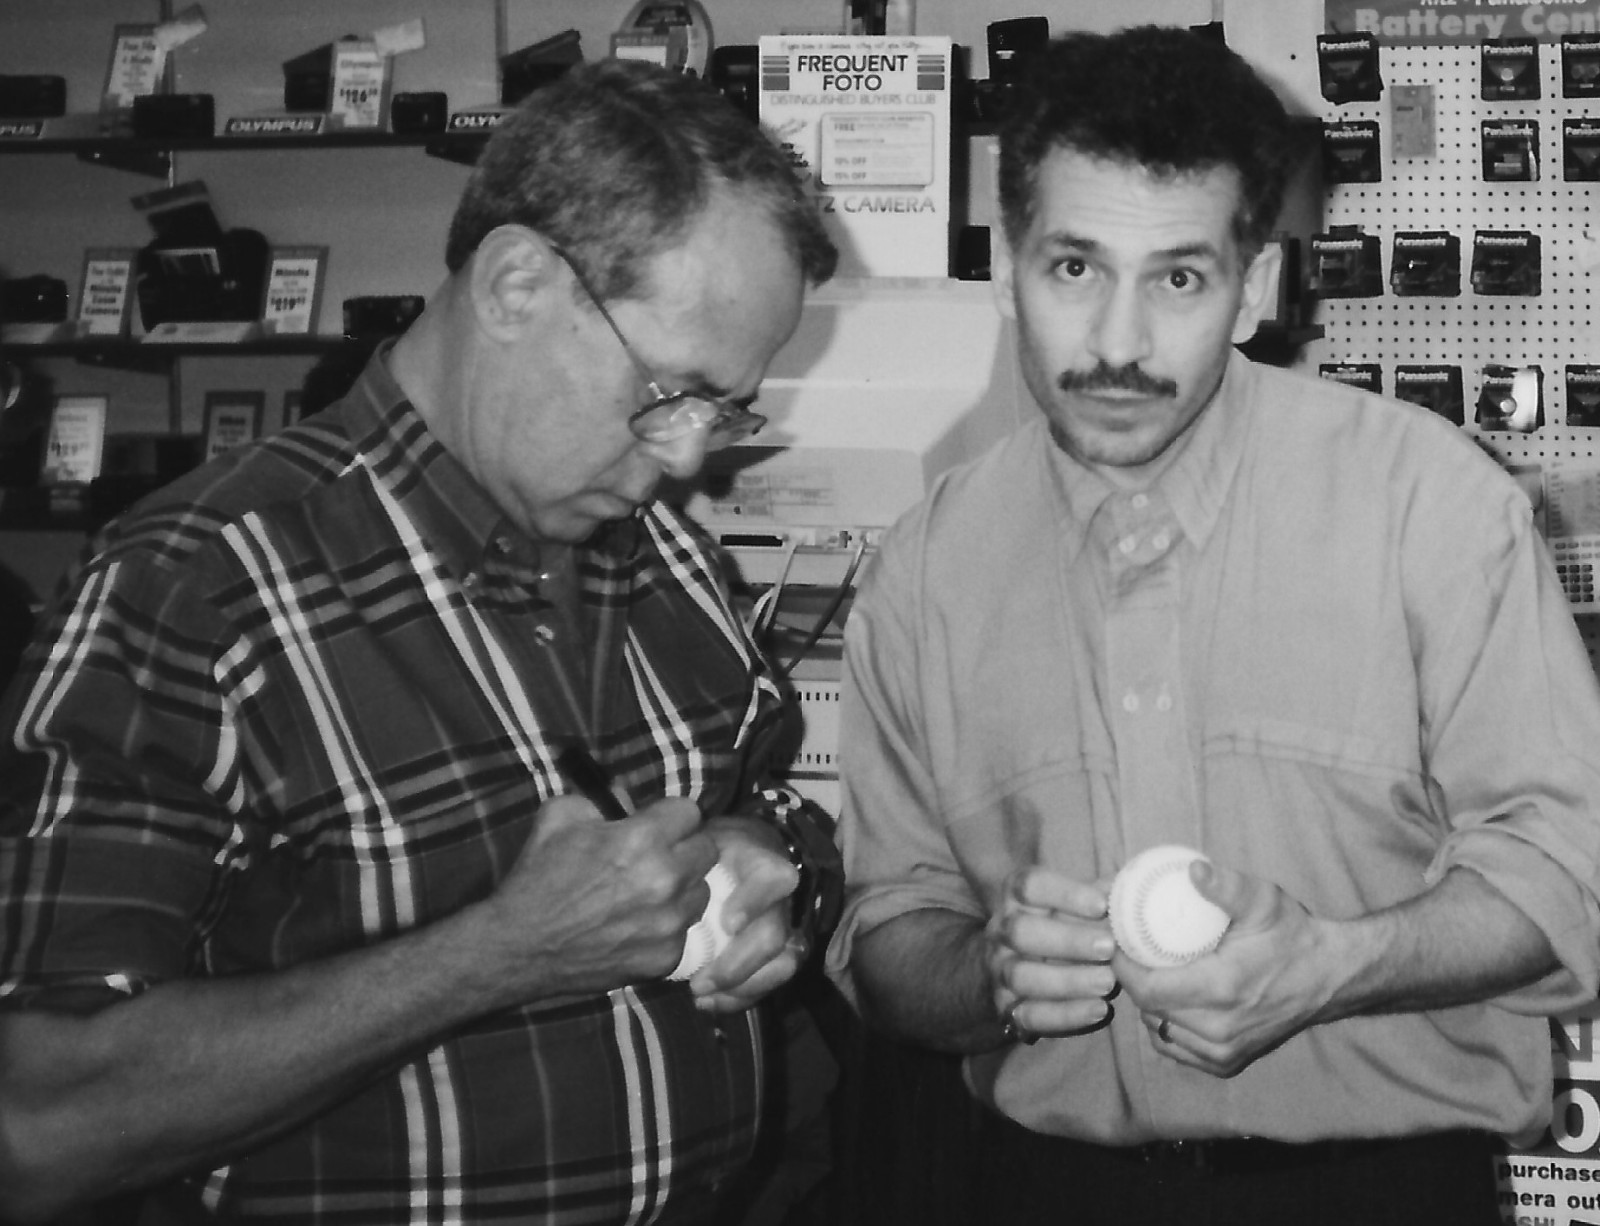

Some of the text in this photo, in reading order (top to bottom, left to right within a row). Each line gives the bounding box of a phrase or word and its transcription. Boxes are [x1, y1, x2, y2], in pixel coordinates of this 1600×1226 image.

[1355, 5, 1600, 39] Battery Cen
[1320, 39, 1370, 50] Panasonic
[1483, 45, 1533, 55] Panasonic
[797, 55, 908, 72] FREQUENT
[823, 75, 882, 91] FOTO
[770, 94, 936, 105] DISTINGUISHED BUYERS CLUB
[231, 120, 314, 131] OLYMPUS
[1483, 126, 1533, 136] Panasonic
[1324, 128, 1374, 138] Panasonic
[844, 196, 936, 213] CAMERA
[1313, 239, 1363, 250] Panasonic
[1396, 236, 1446, 246] Panasonic
[1477, 235, 1528, 246] Panasonic
[1398, 371, 1448, 382] Panasonic
[1498, 1163, 1600, 1182] purchase
